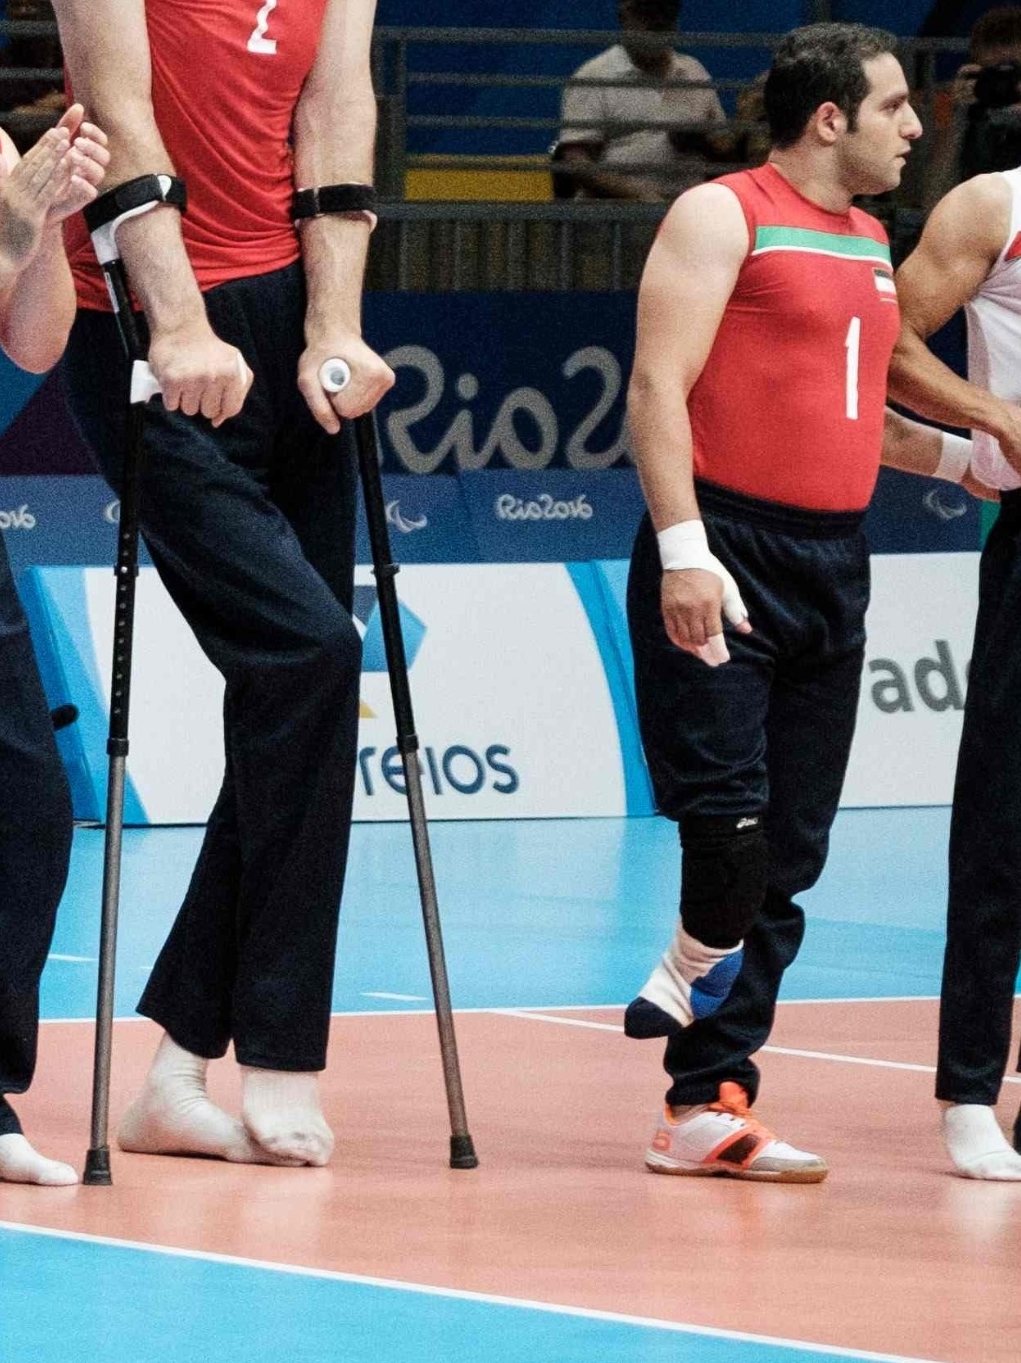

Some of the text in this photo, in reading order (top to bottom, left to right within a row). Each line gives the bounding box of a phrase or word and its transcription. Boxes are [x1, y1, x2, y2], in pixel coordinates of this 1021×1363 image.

[373, 344, 636, 474] Rio2
[844, 316, 861, 420] 1
[496, 493, 594, 520] Rio2016
[868, 640, 972, 713] ad
